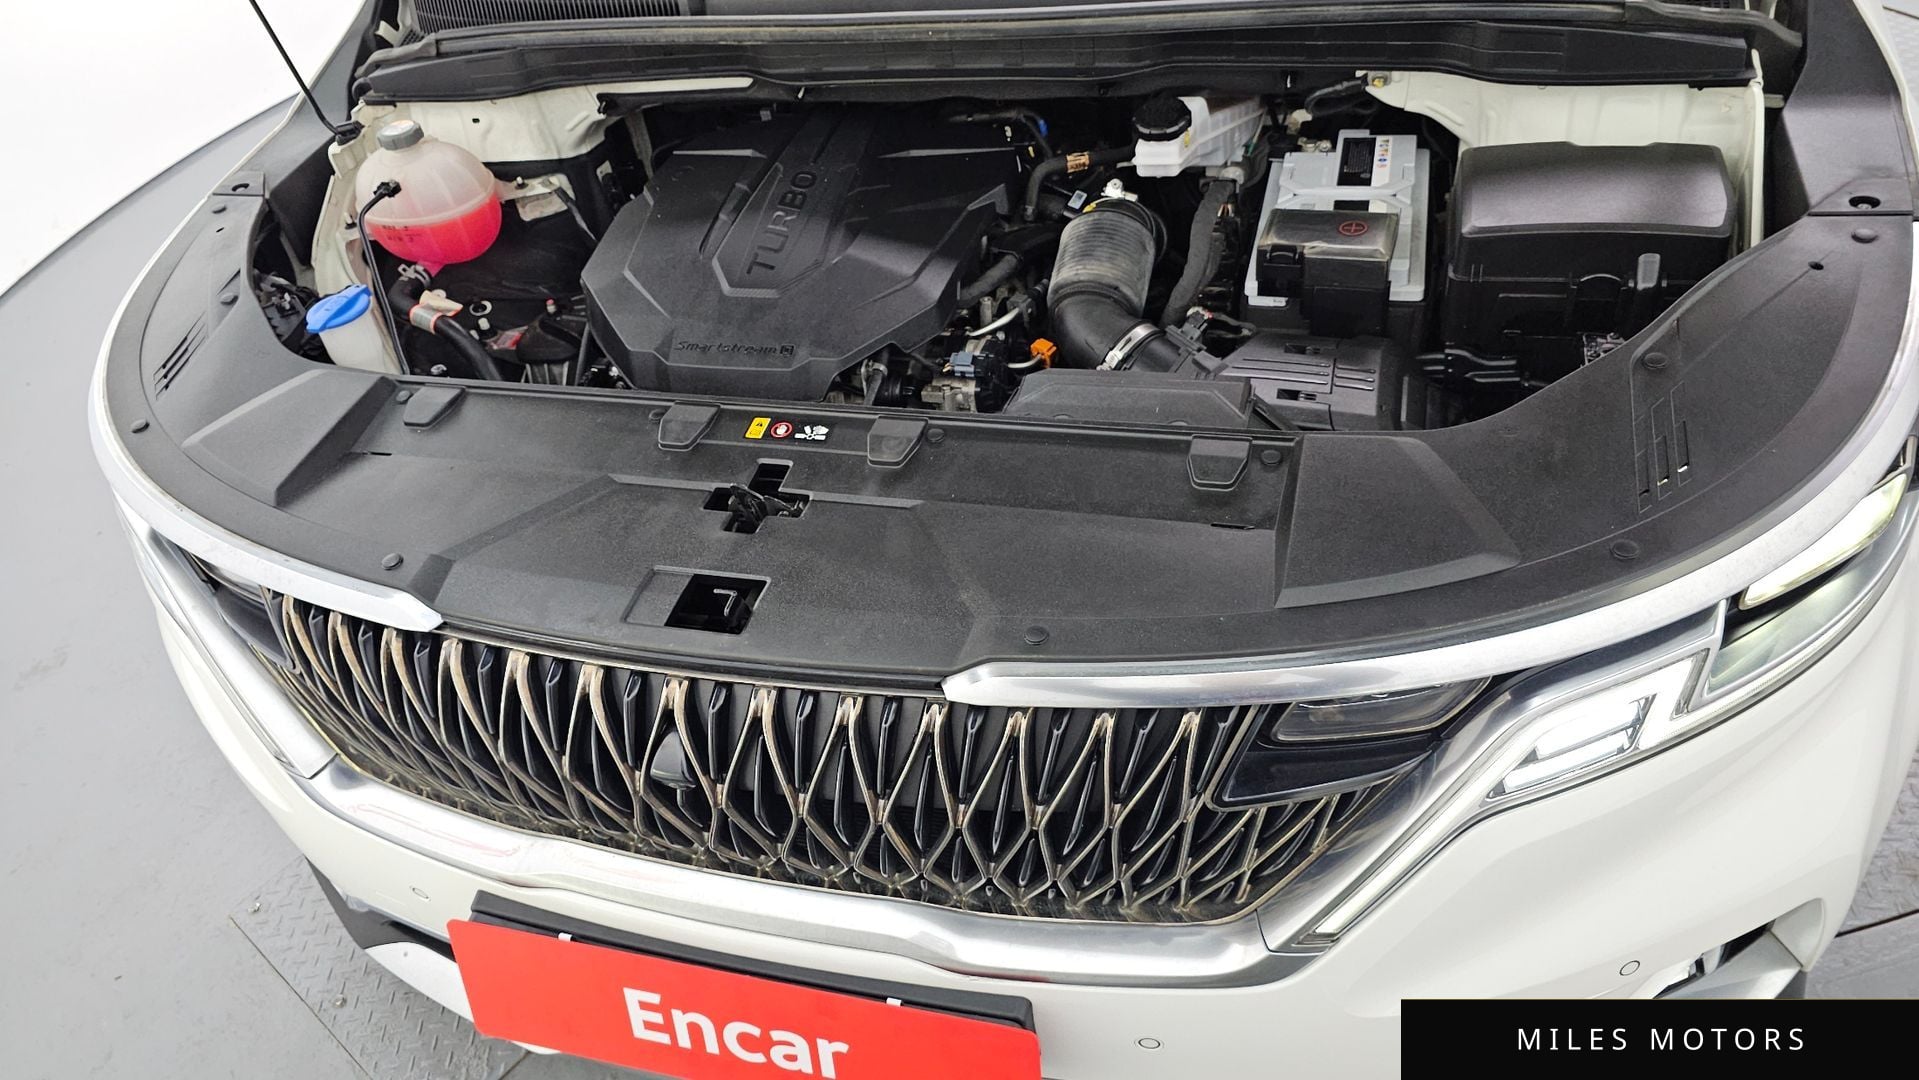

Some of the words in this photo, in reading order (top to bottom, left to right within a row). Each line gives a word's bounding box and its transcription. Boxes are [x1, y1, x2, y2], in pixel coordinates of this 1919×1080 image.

[745, 171, 818, 275] TURBO
[673, 341, 777, 354] Smartstream
[623, 986, 850, 1079] Encar
